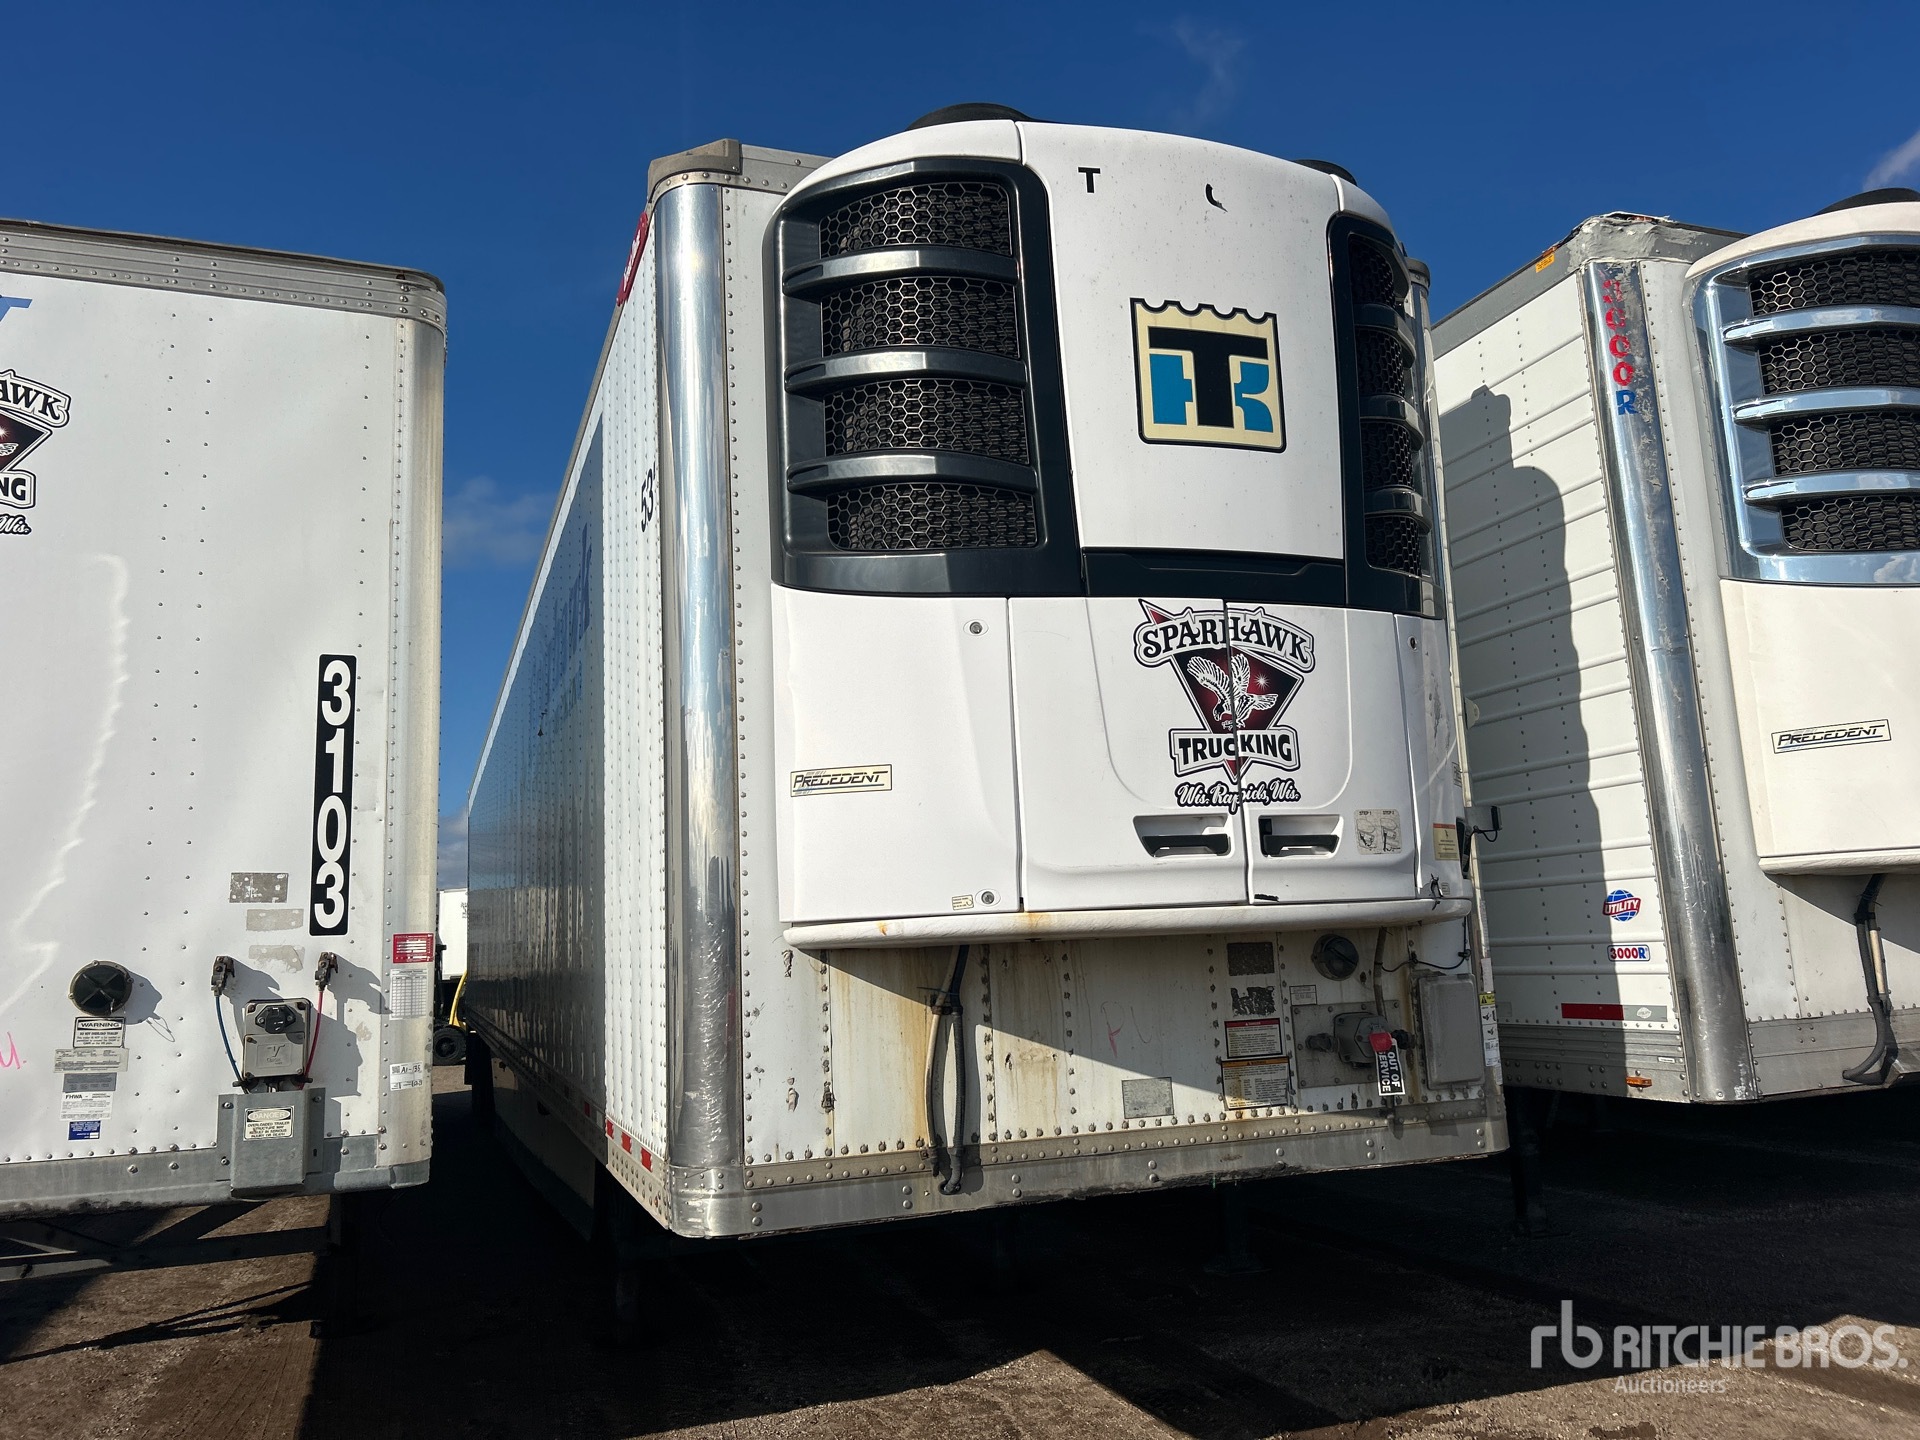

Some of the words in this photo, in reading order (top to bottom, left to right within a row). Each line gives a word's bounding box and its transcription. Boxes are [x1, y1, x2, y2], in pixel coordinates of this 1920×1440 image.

[1142, 616, 1309, 664] SPARHAWK
[1778, 724, 1886, 746] PRECEDENT
[1178, 733, 1293, 766] TRUCKING
[793, 770, 889, 789] PRECEDENT
[313, 659, 352, 929] 3103
[1176, 782, 1209, 806] Wis.
[1269, 778, 1301, 801] Wis.
[1604, 899, 1640, 915] UTILITY
[1610, 947, 1647, 960] 3000R
[1387, 1051, 1399, 1071] OUT
[1391, 1073, 1401, 1088] OF
[252, 1112, 286, 1120] DANGER
